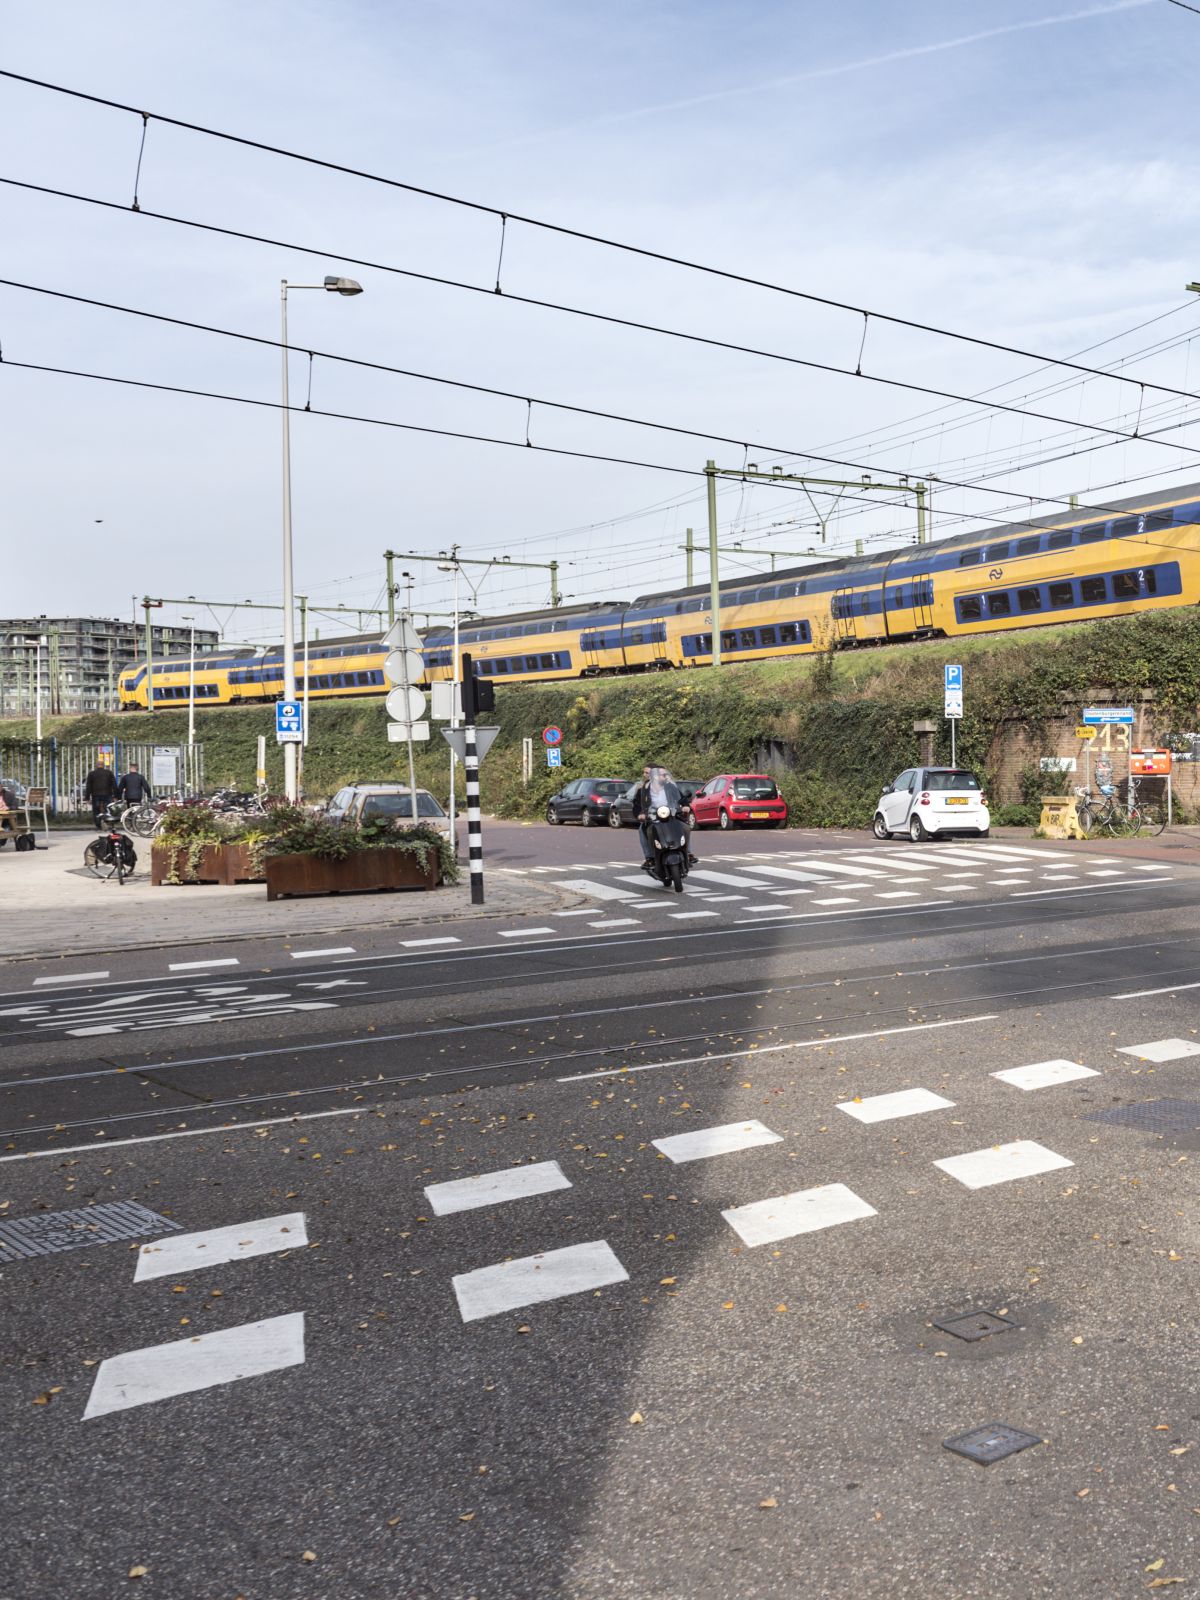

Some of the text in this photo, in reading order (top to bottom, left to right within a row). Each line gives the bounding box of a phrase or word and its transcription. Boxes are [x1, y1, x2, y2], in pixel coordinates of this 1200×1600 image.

[1137, 521, 1144, 533] 2
[982, 552, 986, 562] 1
[1138, 569, 1145, 582] 2
[981, 594, 986, 605] 1
[948, 667, 958, 681] P
[550, 750, 558, 760] P
